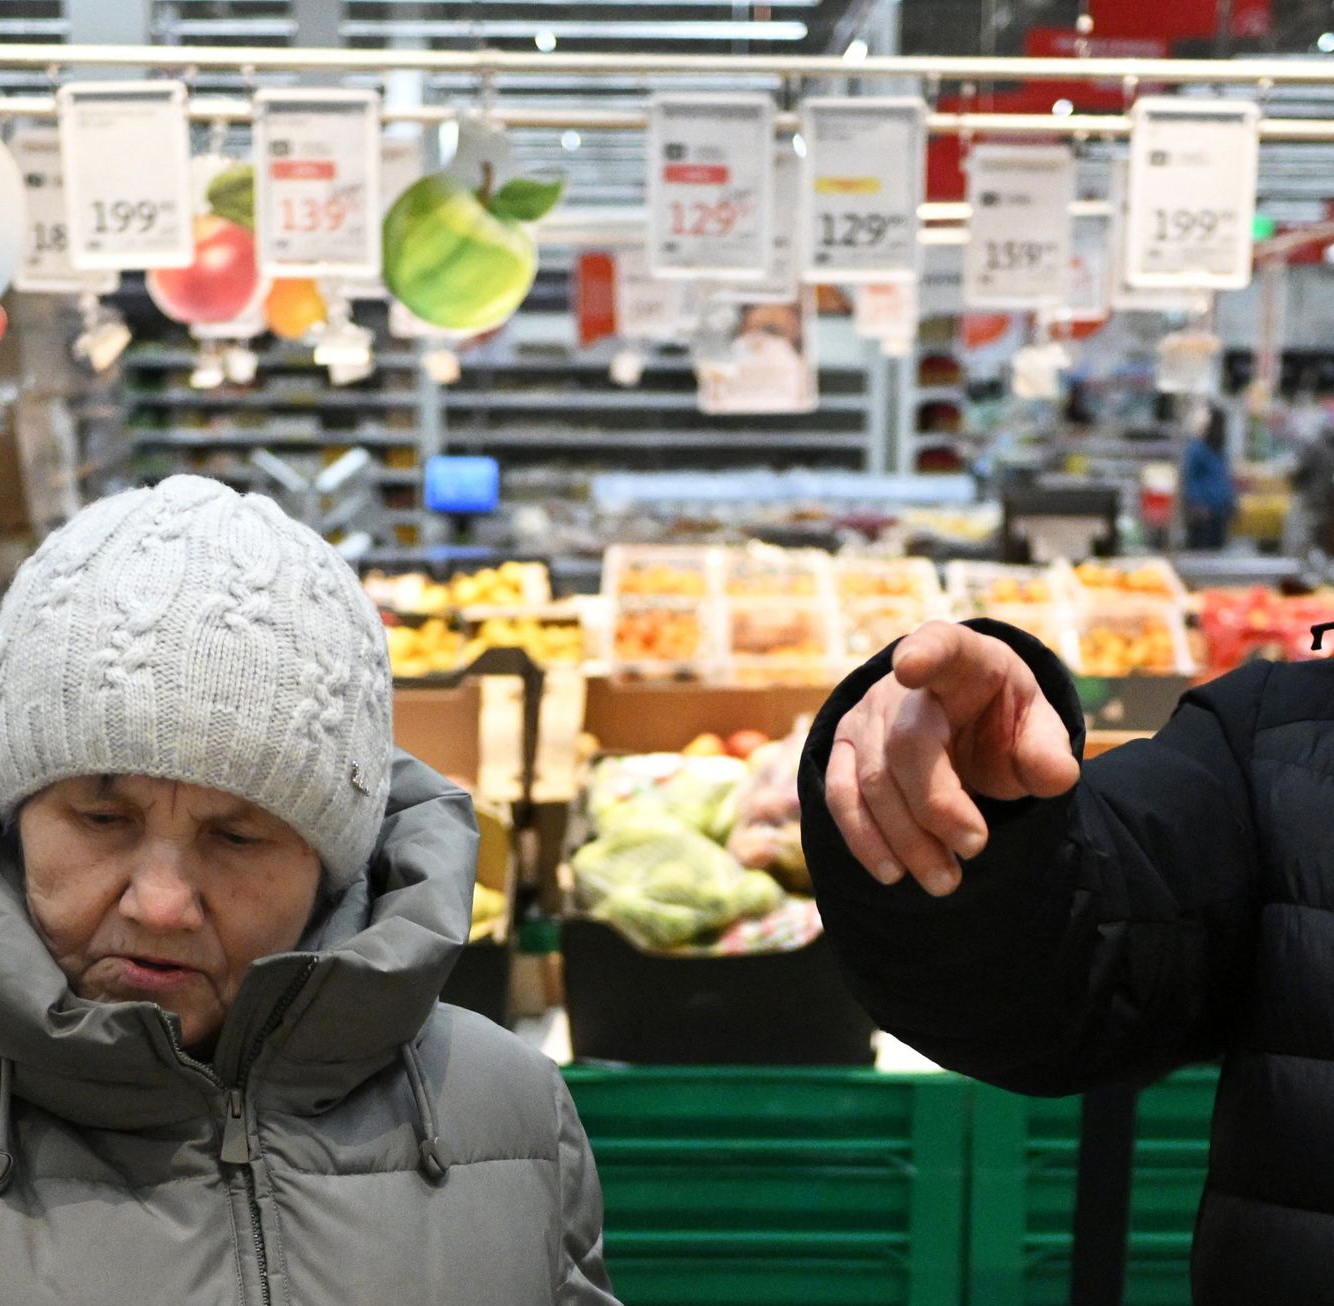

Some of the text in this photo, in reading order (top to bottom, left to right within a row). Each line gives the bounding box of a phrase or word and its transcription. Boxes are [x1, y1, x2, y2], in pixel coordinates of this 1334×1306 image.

[92, 199, 158, 234] 199
[283, 198, 346, 232] 139
[822, 213, 888, 247] 129
[1155, 209, 1217, 241] 199
[33, 222, 67, 252] 18
